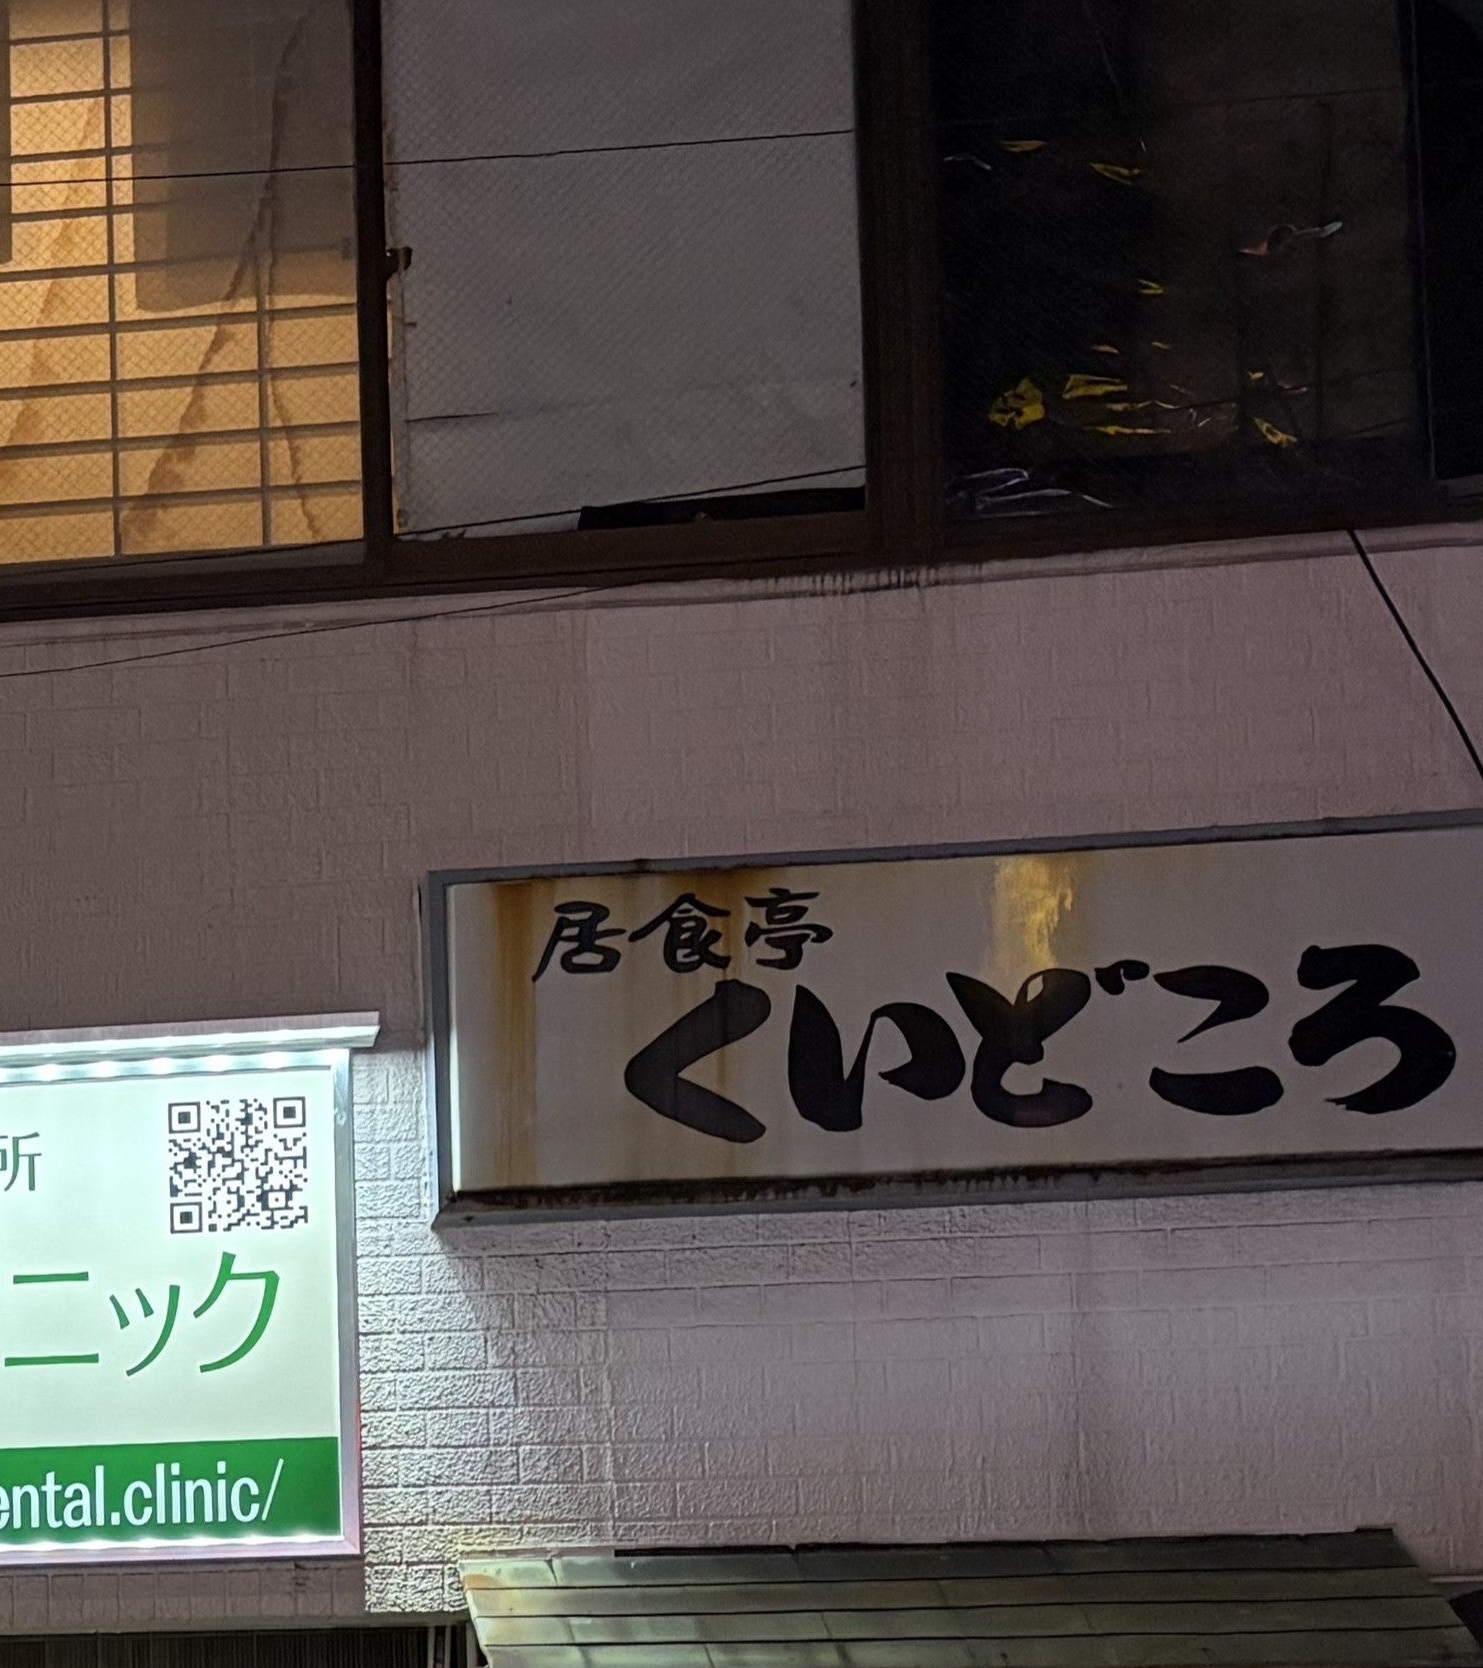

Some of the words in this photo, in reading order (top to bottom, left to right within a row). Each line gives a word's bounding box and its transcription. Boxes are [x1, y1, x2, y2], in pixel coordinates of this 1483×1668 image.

[533, 886, 833, 982] 居食亭
[625, 943, 1457, 1143] くいどころ
